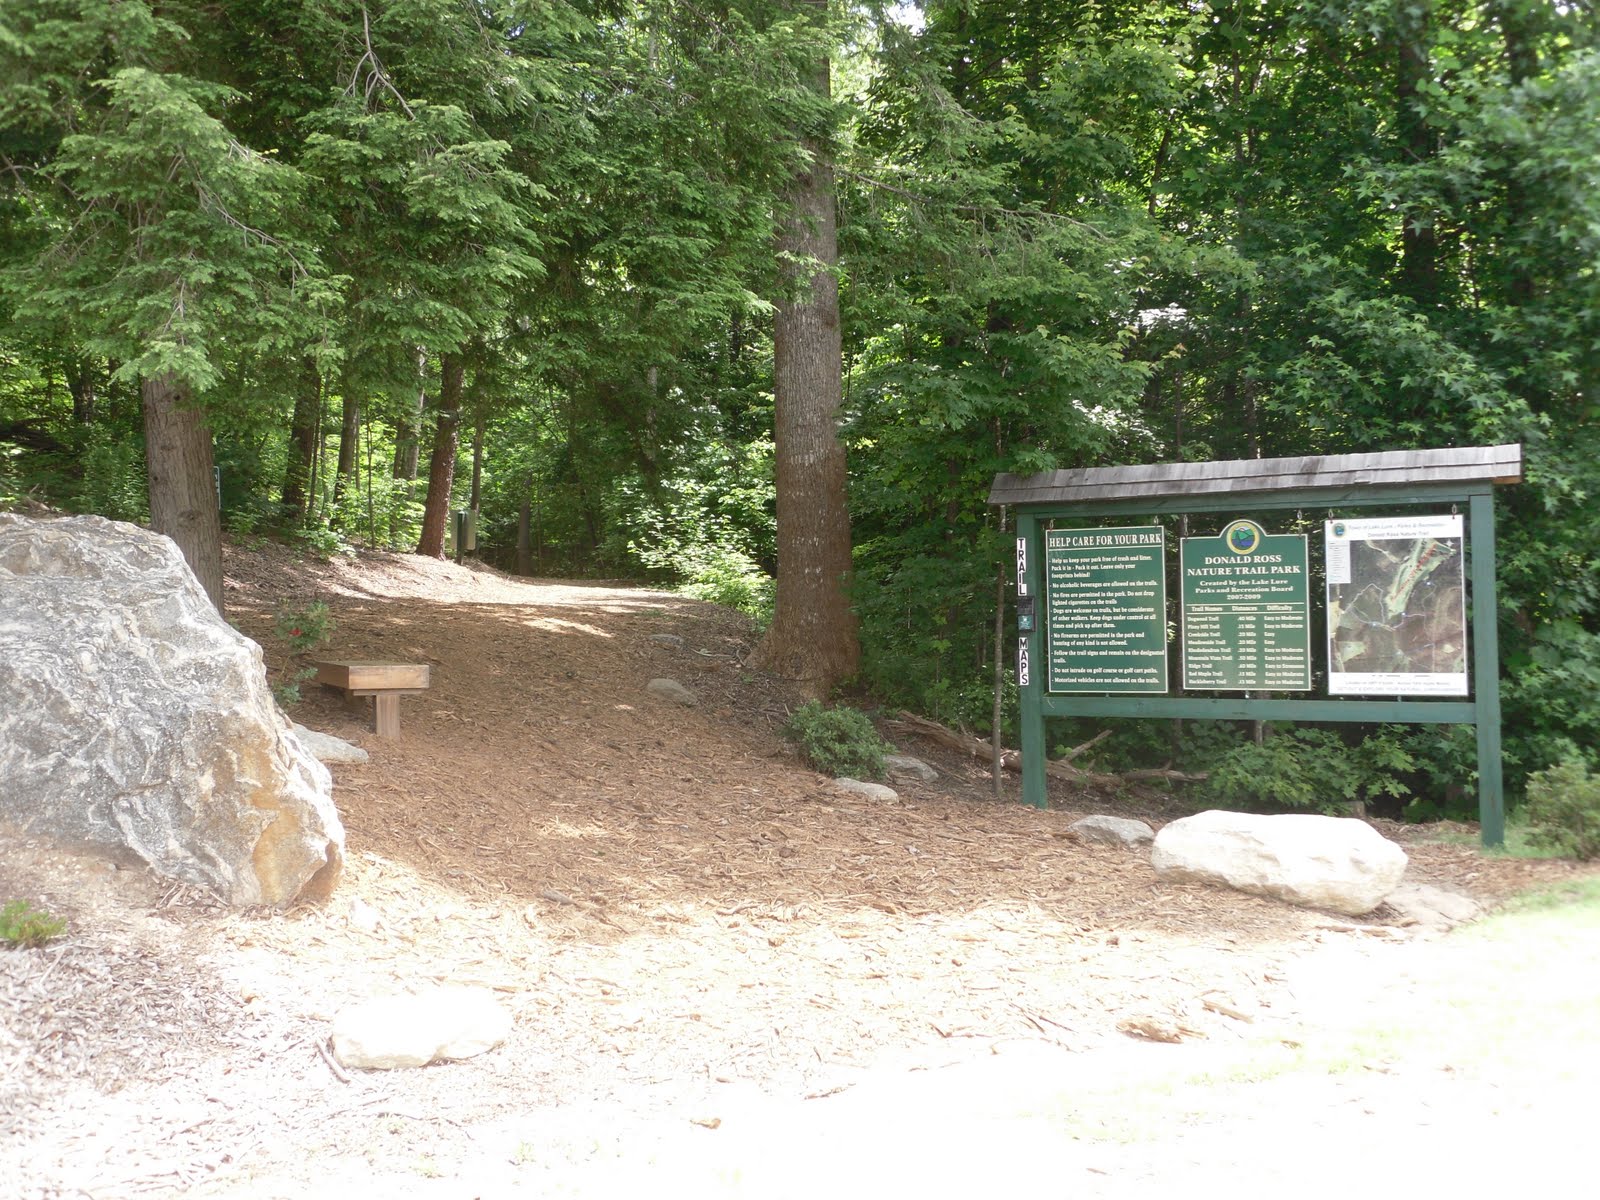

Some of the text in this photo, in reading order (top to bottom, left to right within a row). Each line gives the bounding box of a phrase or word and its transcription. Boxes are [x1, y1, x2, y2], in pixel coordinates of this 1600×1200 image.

[1050, 534, 1161, 547] HELP CARE FOR YOUR PARK
[1205, 555, 1281, 564] DONALD ROSS
[1018, 538, 1026, 595] TRAIL
[1187, 565, 1300, 576] NATURE TRAIL PARK
[1020, 638, 1028, 685] MAPS
